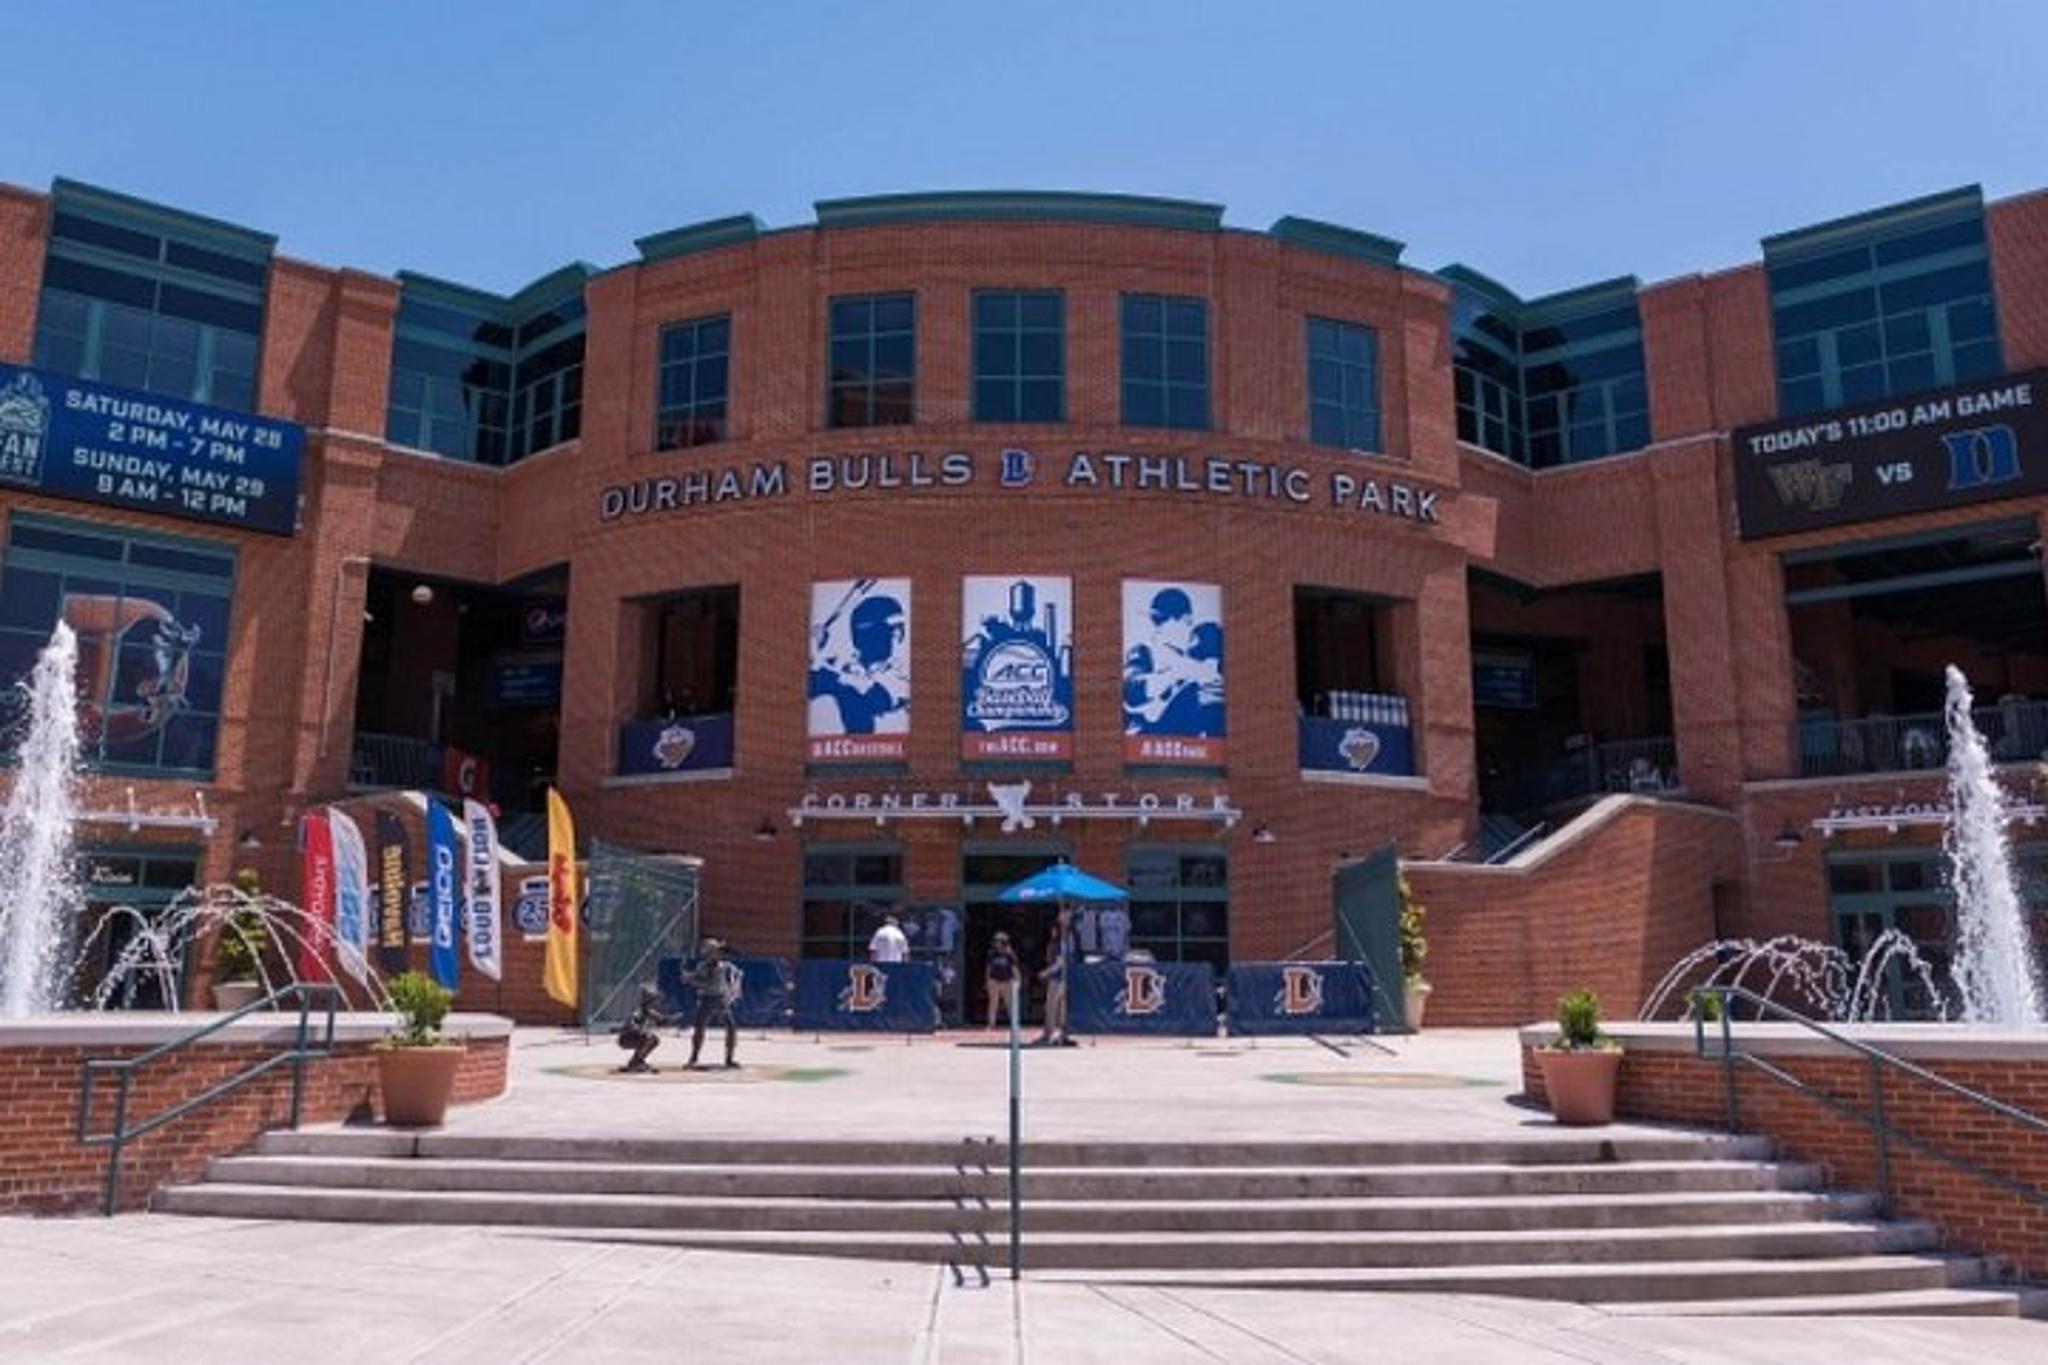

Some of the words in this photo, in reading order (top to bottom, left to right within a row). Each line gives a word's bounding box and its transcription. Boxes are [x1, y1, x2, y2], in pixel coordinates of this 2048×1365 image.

[65, 389, 193, 432] SATURDAY,
[200, 418, 248, 442] MAY
[253, 427, 283, 449] 28
[1749, 421, 1843, 456] TODAY'S
[1847, 409, 1907, 438] 11:00
[1912, 401, 1951, 425] AM
[1957, 384, 2032, 416] GAME
[0, 433, 39, 459] AN
[108, 421, 124, 442] 2
[131, 425, 167, 450] PM
[190, 437, 204, 456] 7
[210, 441, 246, 464] PM
[73, 448, 175, 483] SUNDAY,
[182, 467, 230, 491] MAY
[235, 476, 266, 498] 29
[601, 463, 789, 521] DURHAM
[809, 453, 973, 493] BULLS
[1068, 454, 1313, 502] ATHLETIC
[1333, 474, 1440, 521] PARK
[1876, 461, 1914, 485] VS
[117, 476, 157, 502] AM
[182, 487, 205, 511] 12
[210, 494, 247, 517] PM
[992, 662, 1048, 682] ACC
[802, 793, 958, 810] CORNER
[1066, 793, 1231, 811] STORE
